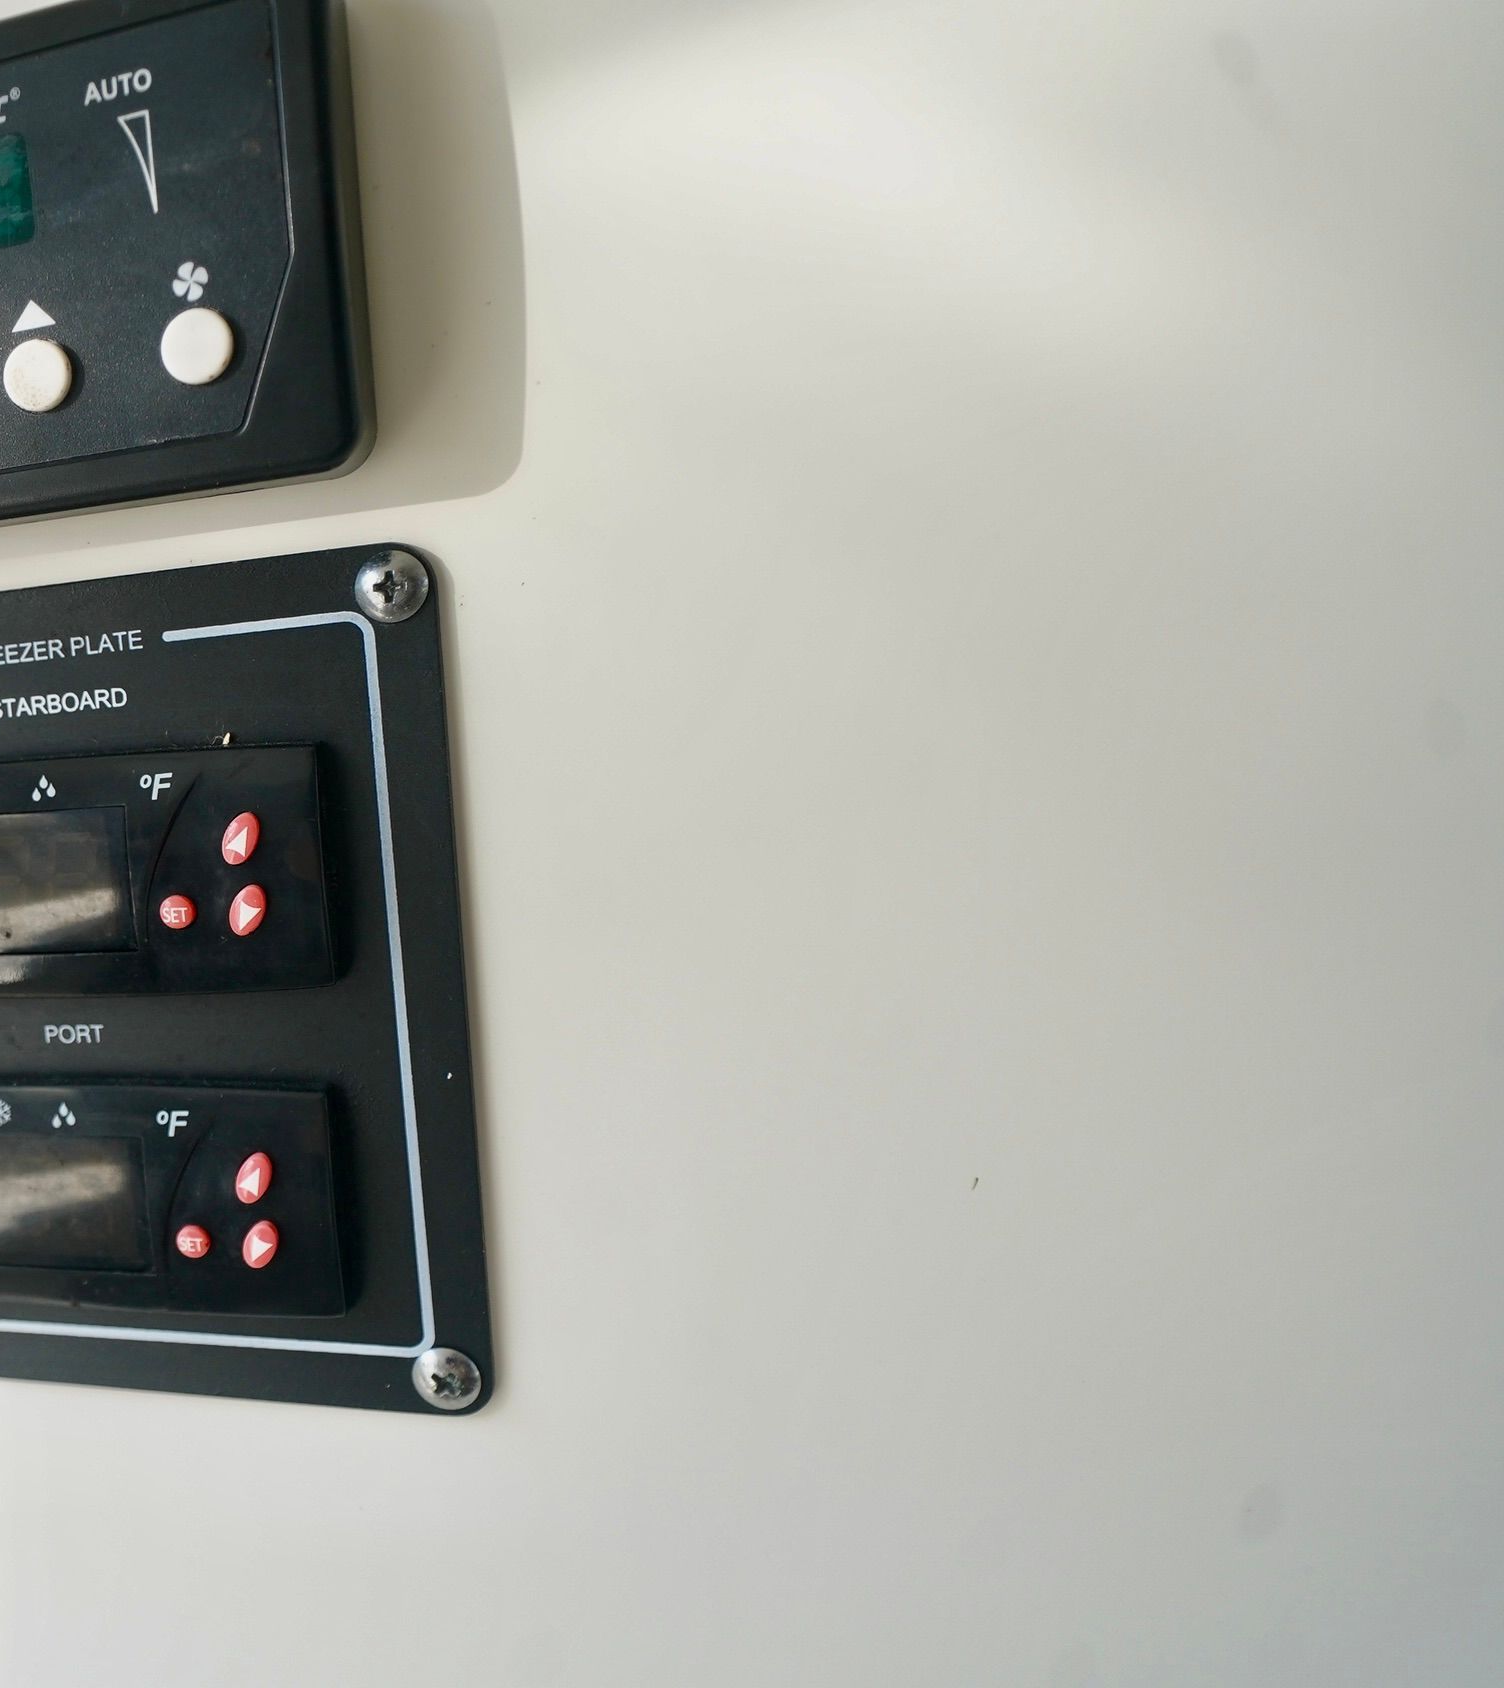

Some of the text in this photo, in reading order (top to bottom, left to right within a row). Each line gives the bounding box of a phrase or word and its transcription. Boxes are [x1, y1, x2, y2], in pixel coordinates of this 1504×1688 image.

[84, 67, 152, 107] AUTO
[69, 629, 144, 658] PLATE
[161, 906, 188, 924] SET
[44, 1023, 104, 1045] PORT
[178, 1236, 204, 1253] SET
